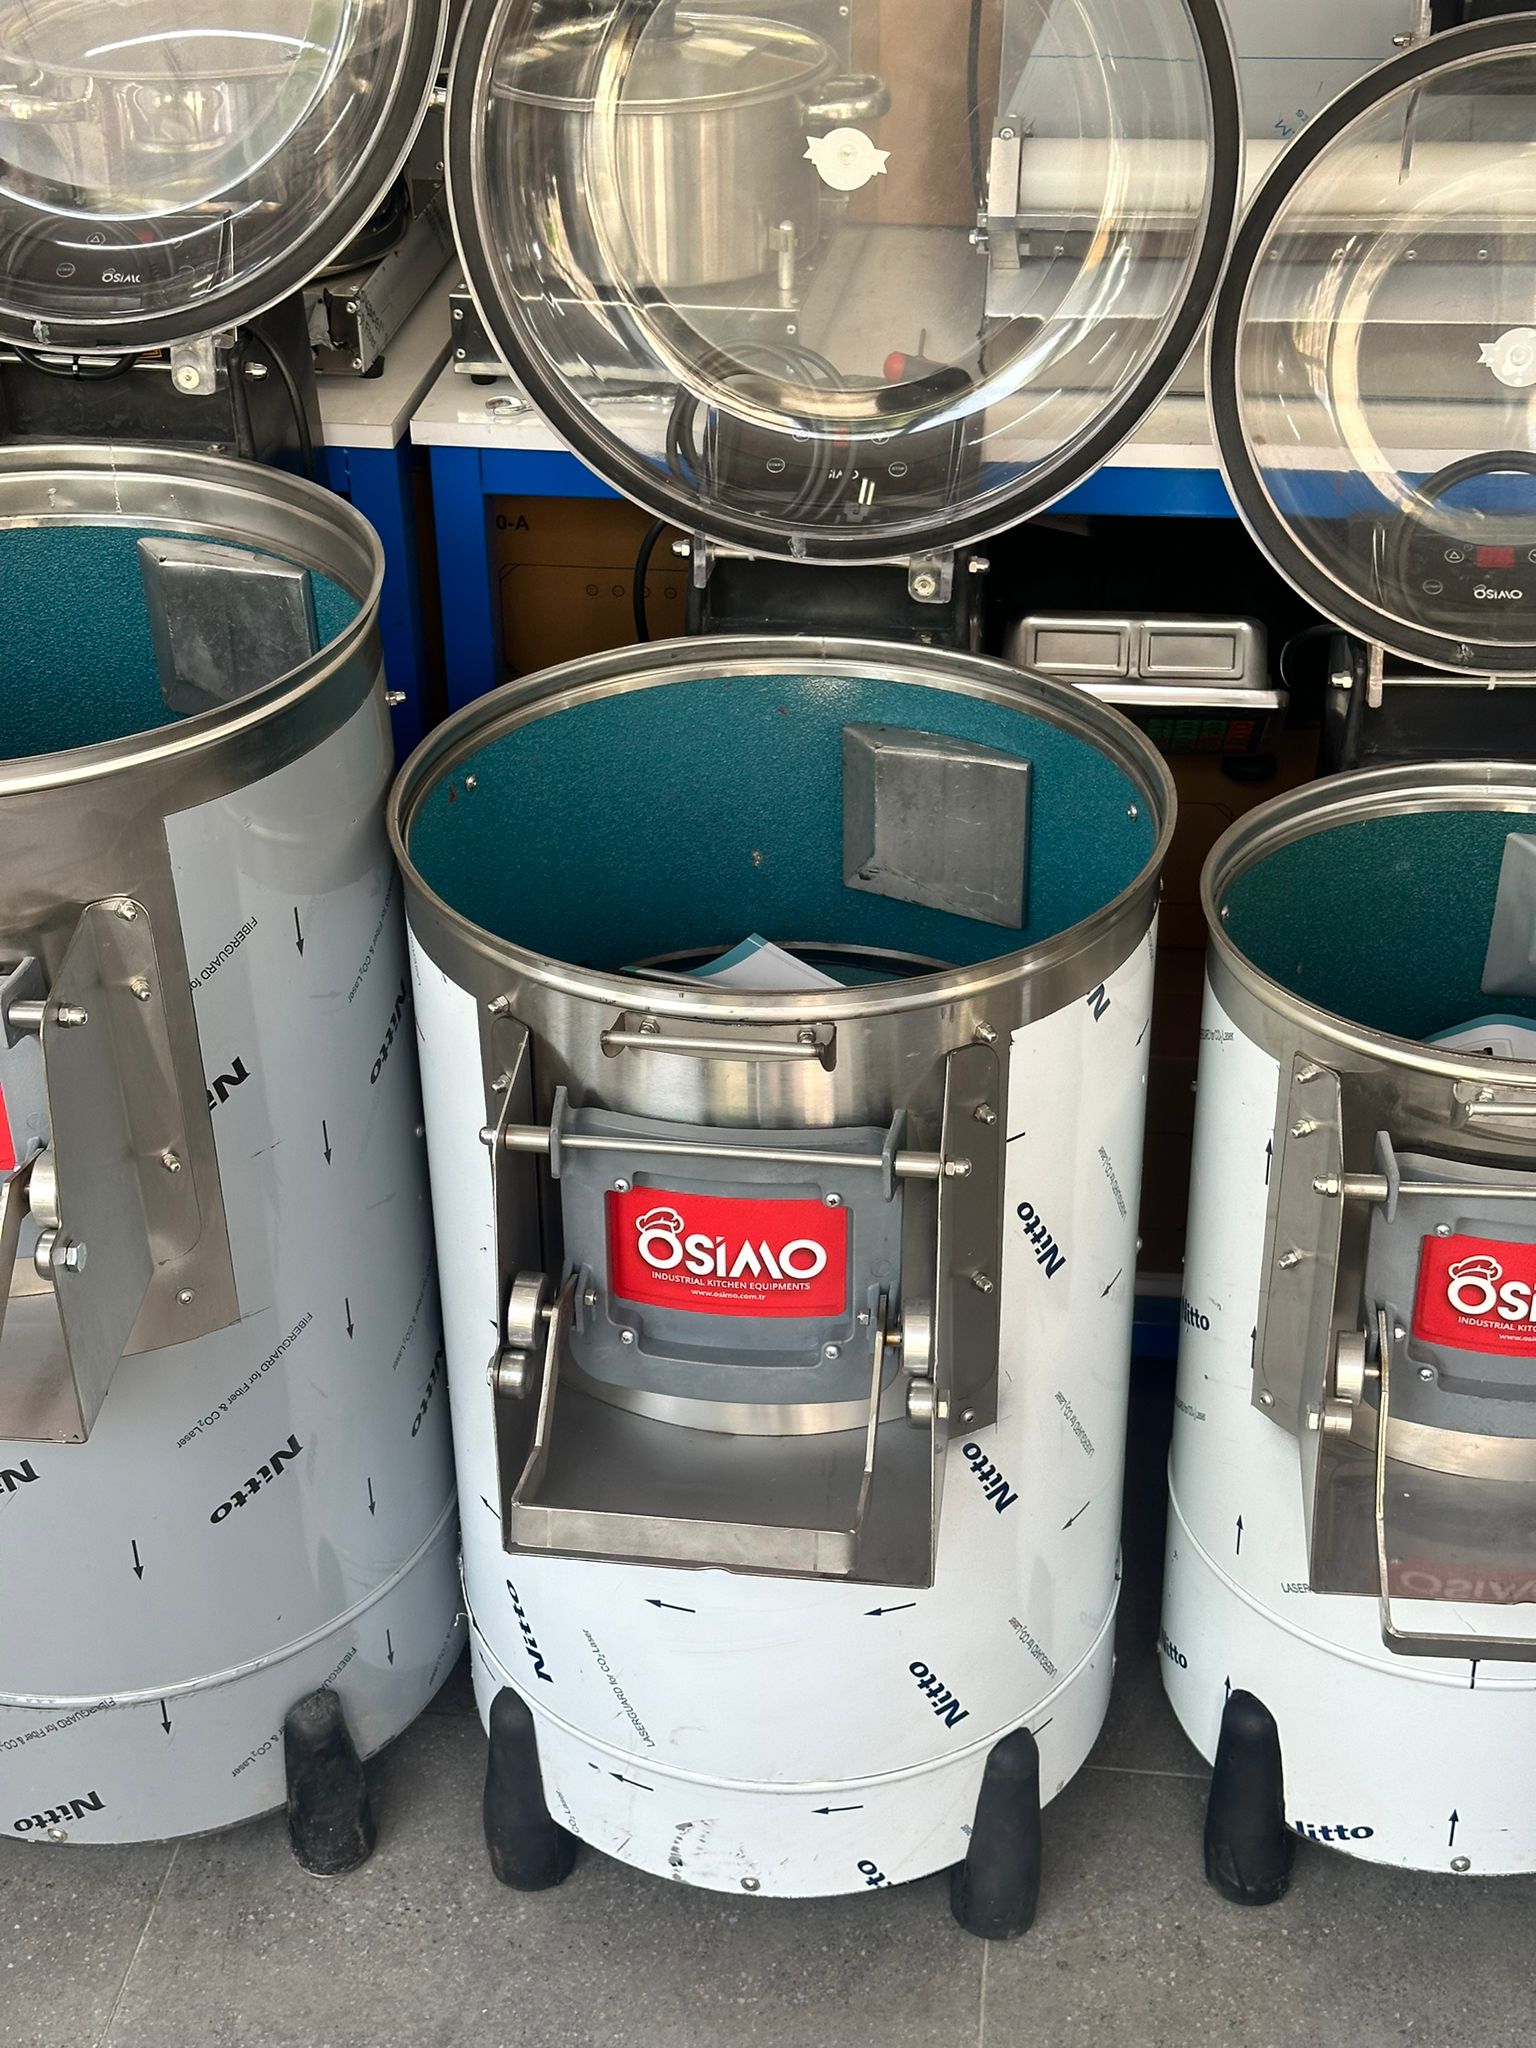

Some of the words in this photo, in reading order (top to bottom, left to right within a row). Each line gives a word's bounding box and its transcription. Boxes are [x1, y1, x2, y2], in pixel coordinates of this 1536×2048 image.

[200, 916, 258, 980] FIBERGUARD
[1016, 1201, 1067, 1280] Nitto
[652, 1271, 704, 1286] INDUSTRIAL
[707, 1279, 747, 1290] KITCHEN
[749, 1282, 811, 1291] EQUIPMENTS
[691, 1289, 766, 1300] www.osimo.com.tr
[1458, 1316, 1515, 1331] INDUSTRIAL
[260, 1312, 313, 1372] FIBERGUARD
[249, 1371, 262, 1384] for
[227, 1382, 250, 1404] Fiber
[218, 1403, 229, 1411] &
[176, 1426, 203, 1449] Laser
[210, 1433, 303, 1524] Nitto
[962, 1442, 1019, 1514] Nitto
[506, 1579, 554, 1684] Nitto
[582, 1629, 600, 1654] Laser
[606, 1673, 619, 1685] for
[909, 1661, 970, 1729] Nitto
[44, 1724, 58, 1732] for
[613, 1686, 656, 1748] LASERGUARD
[16, 1736, 26, 1745] &
[24, 1728, 47, 1741] Fiber
[231, 1756, 256, 1777] Laser
[13, 1790, 106, 1832] Nitto
